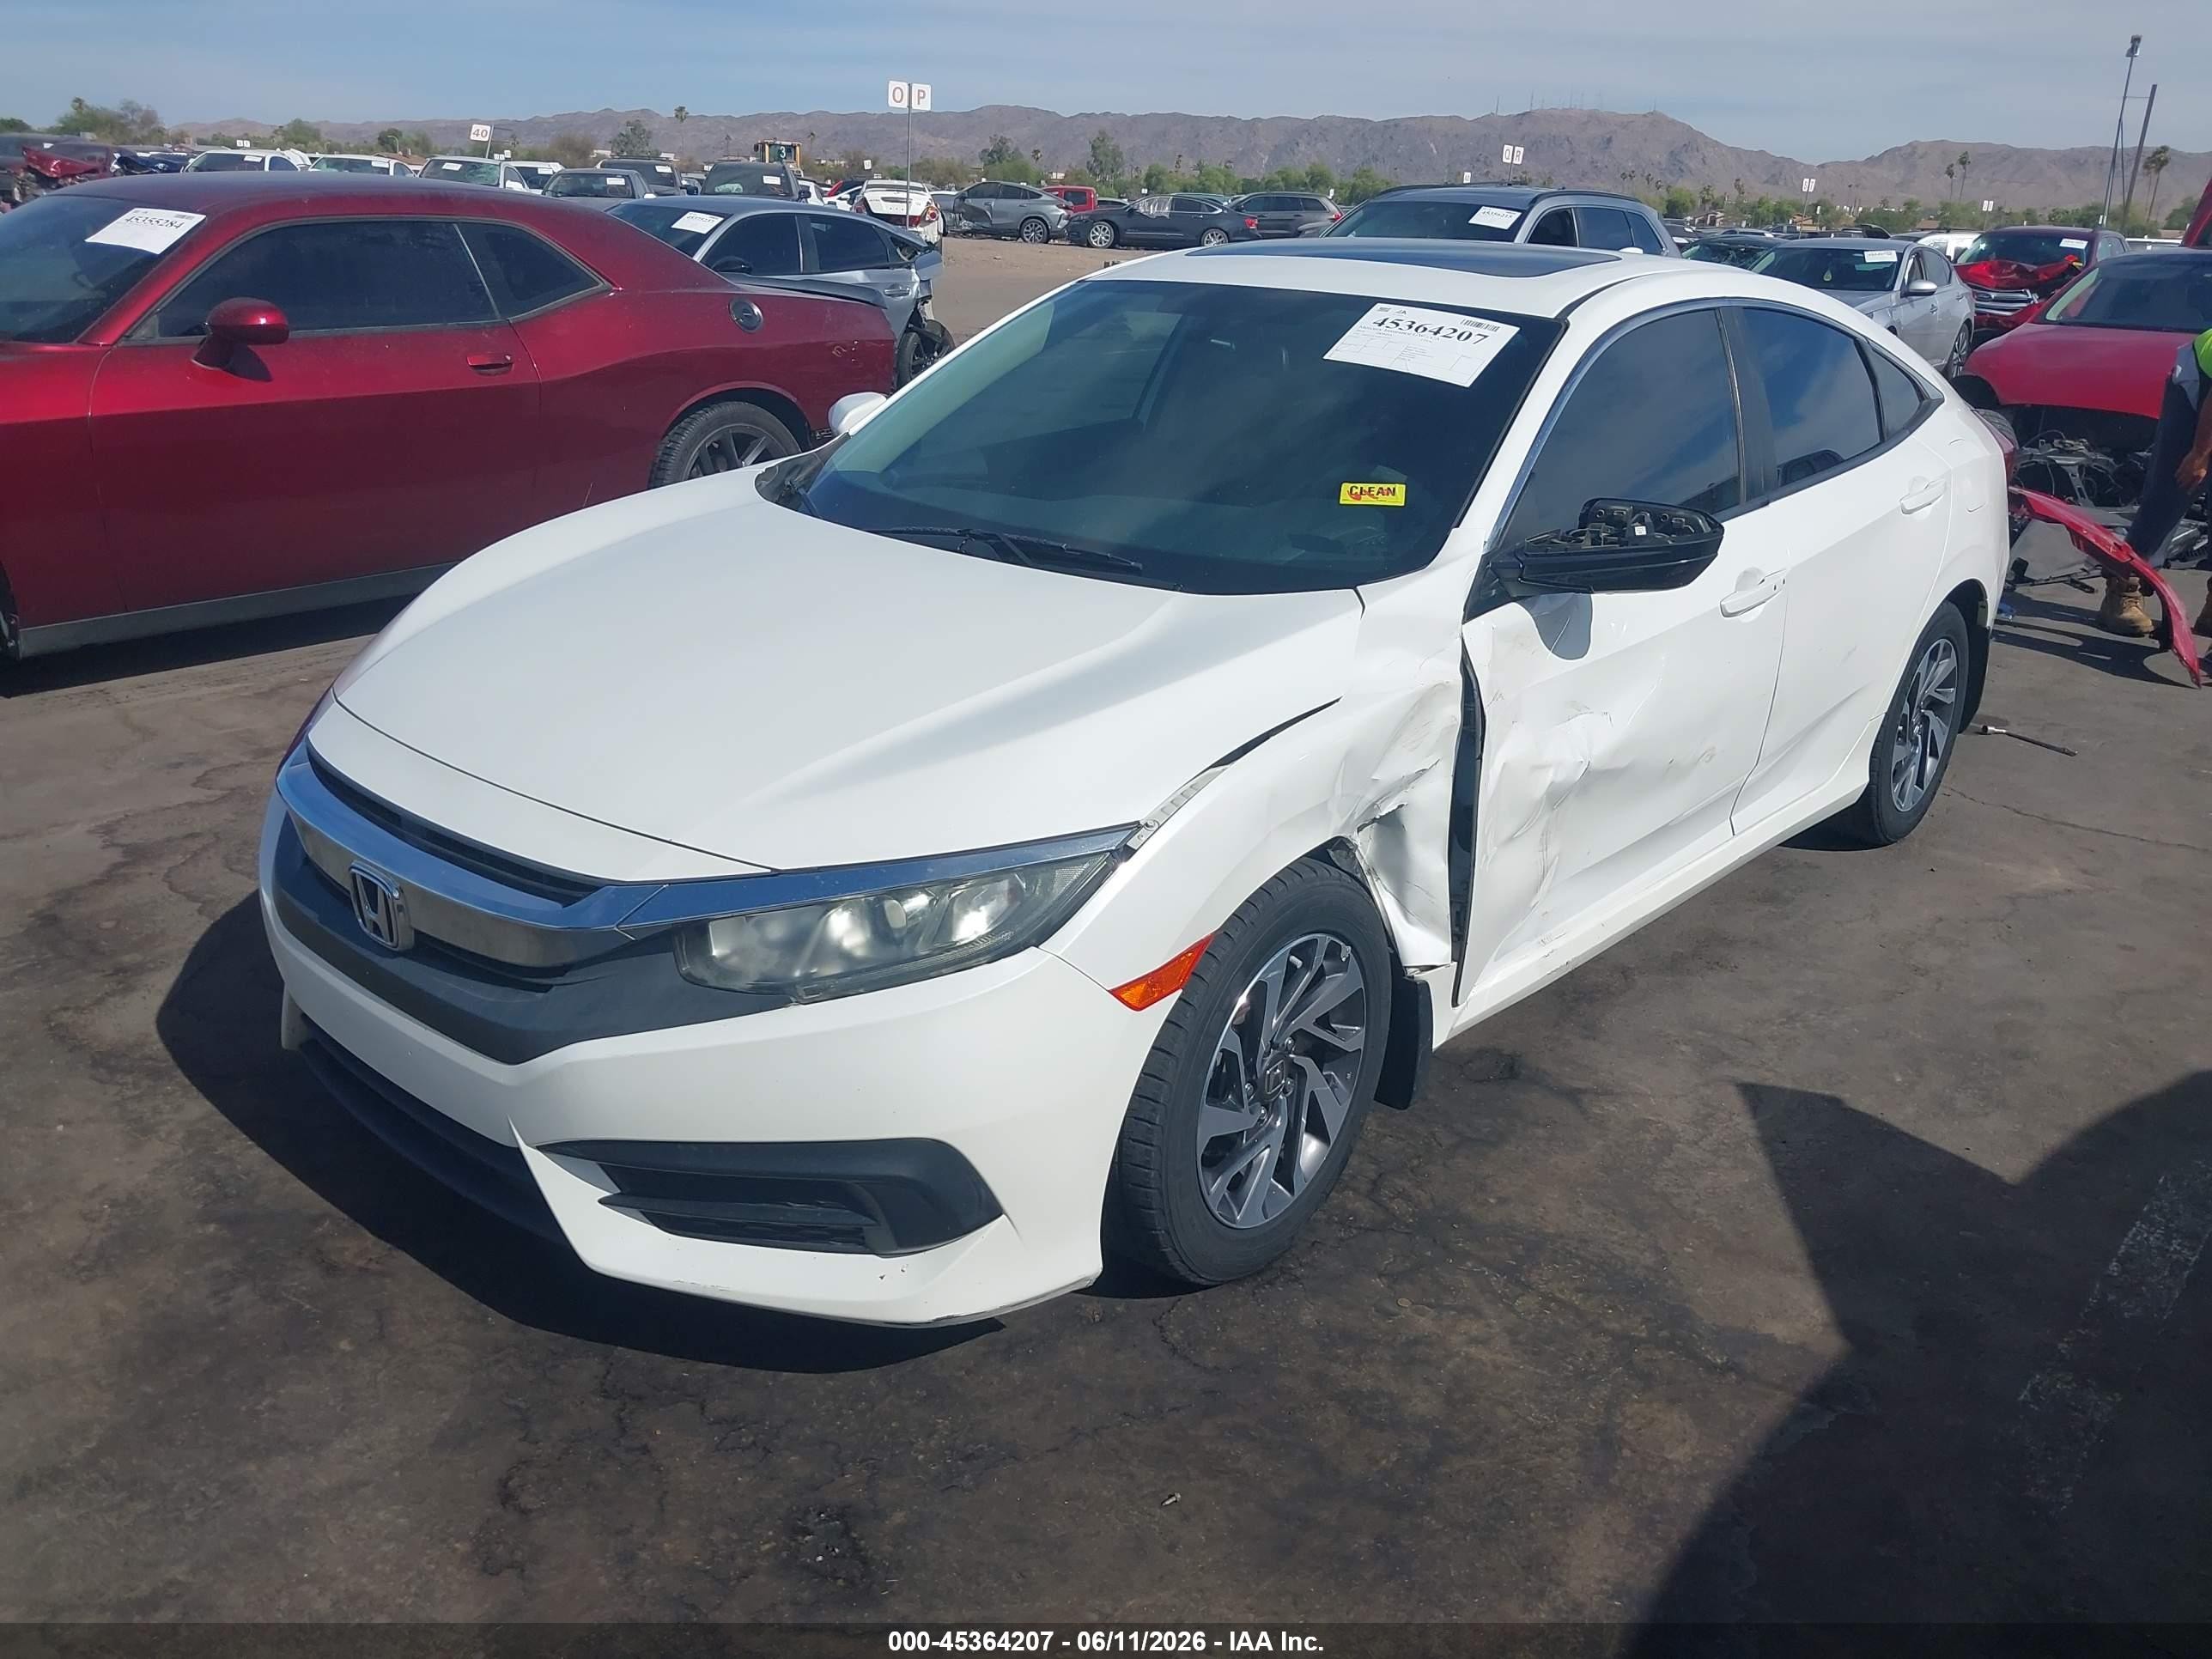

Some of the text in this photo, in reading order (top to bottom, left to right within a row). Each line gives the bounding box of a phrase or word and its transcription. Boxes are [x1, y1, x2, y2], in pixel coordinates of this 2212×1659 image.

[917, 88, 926, 105] P
[472, 129, 488, 137] 40
[780, 145, 787, 159] 3
[1372, 317, 1490, 345] 45364207
[1349, 485, 1396, 496] CLEAN
